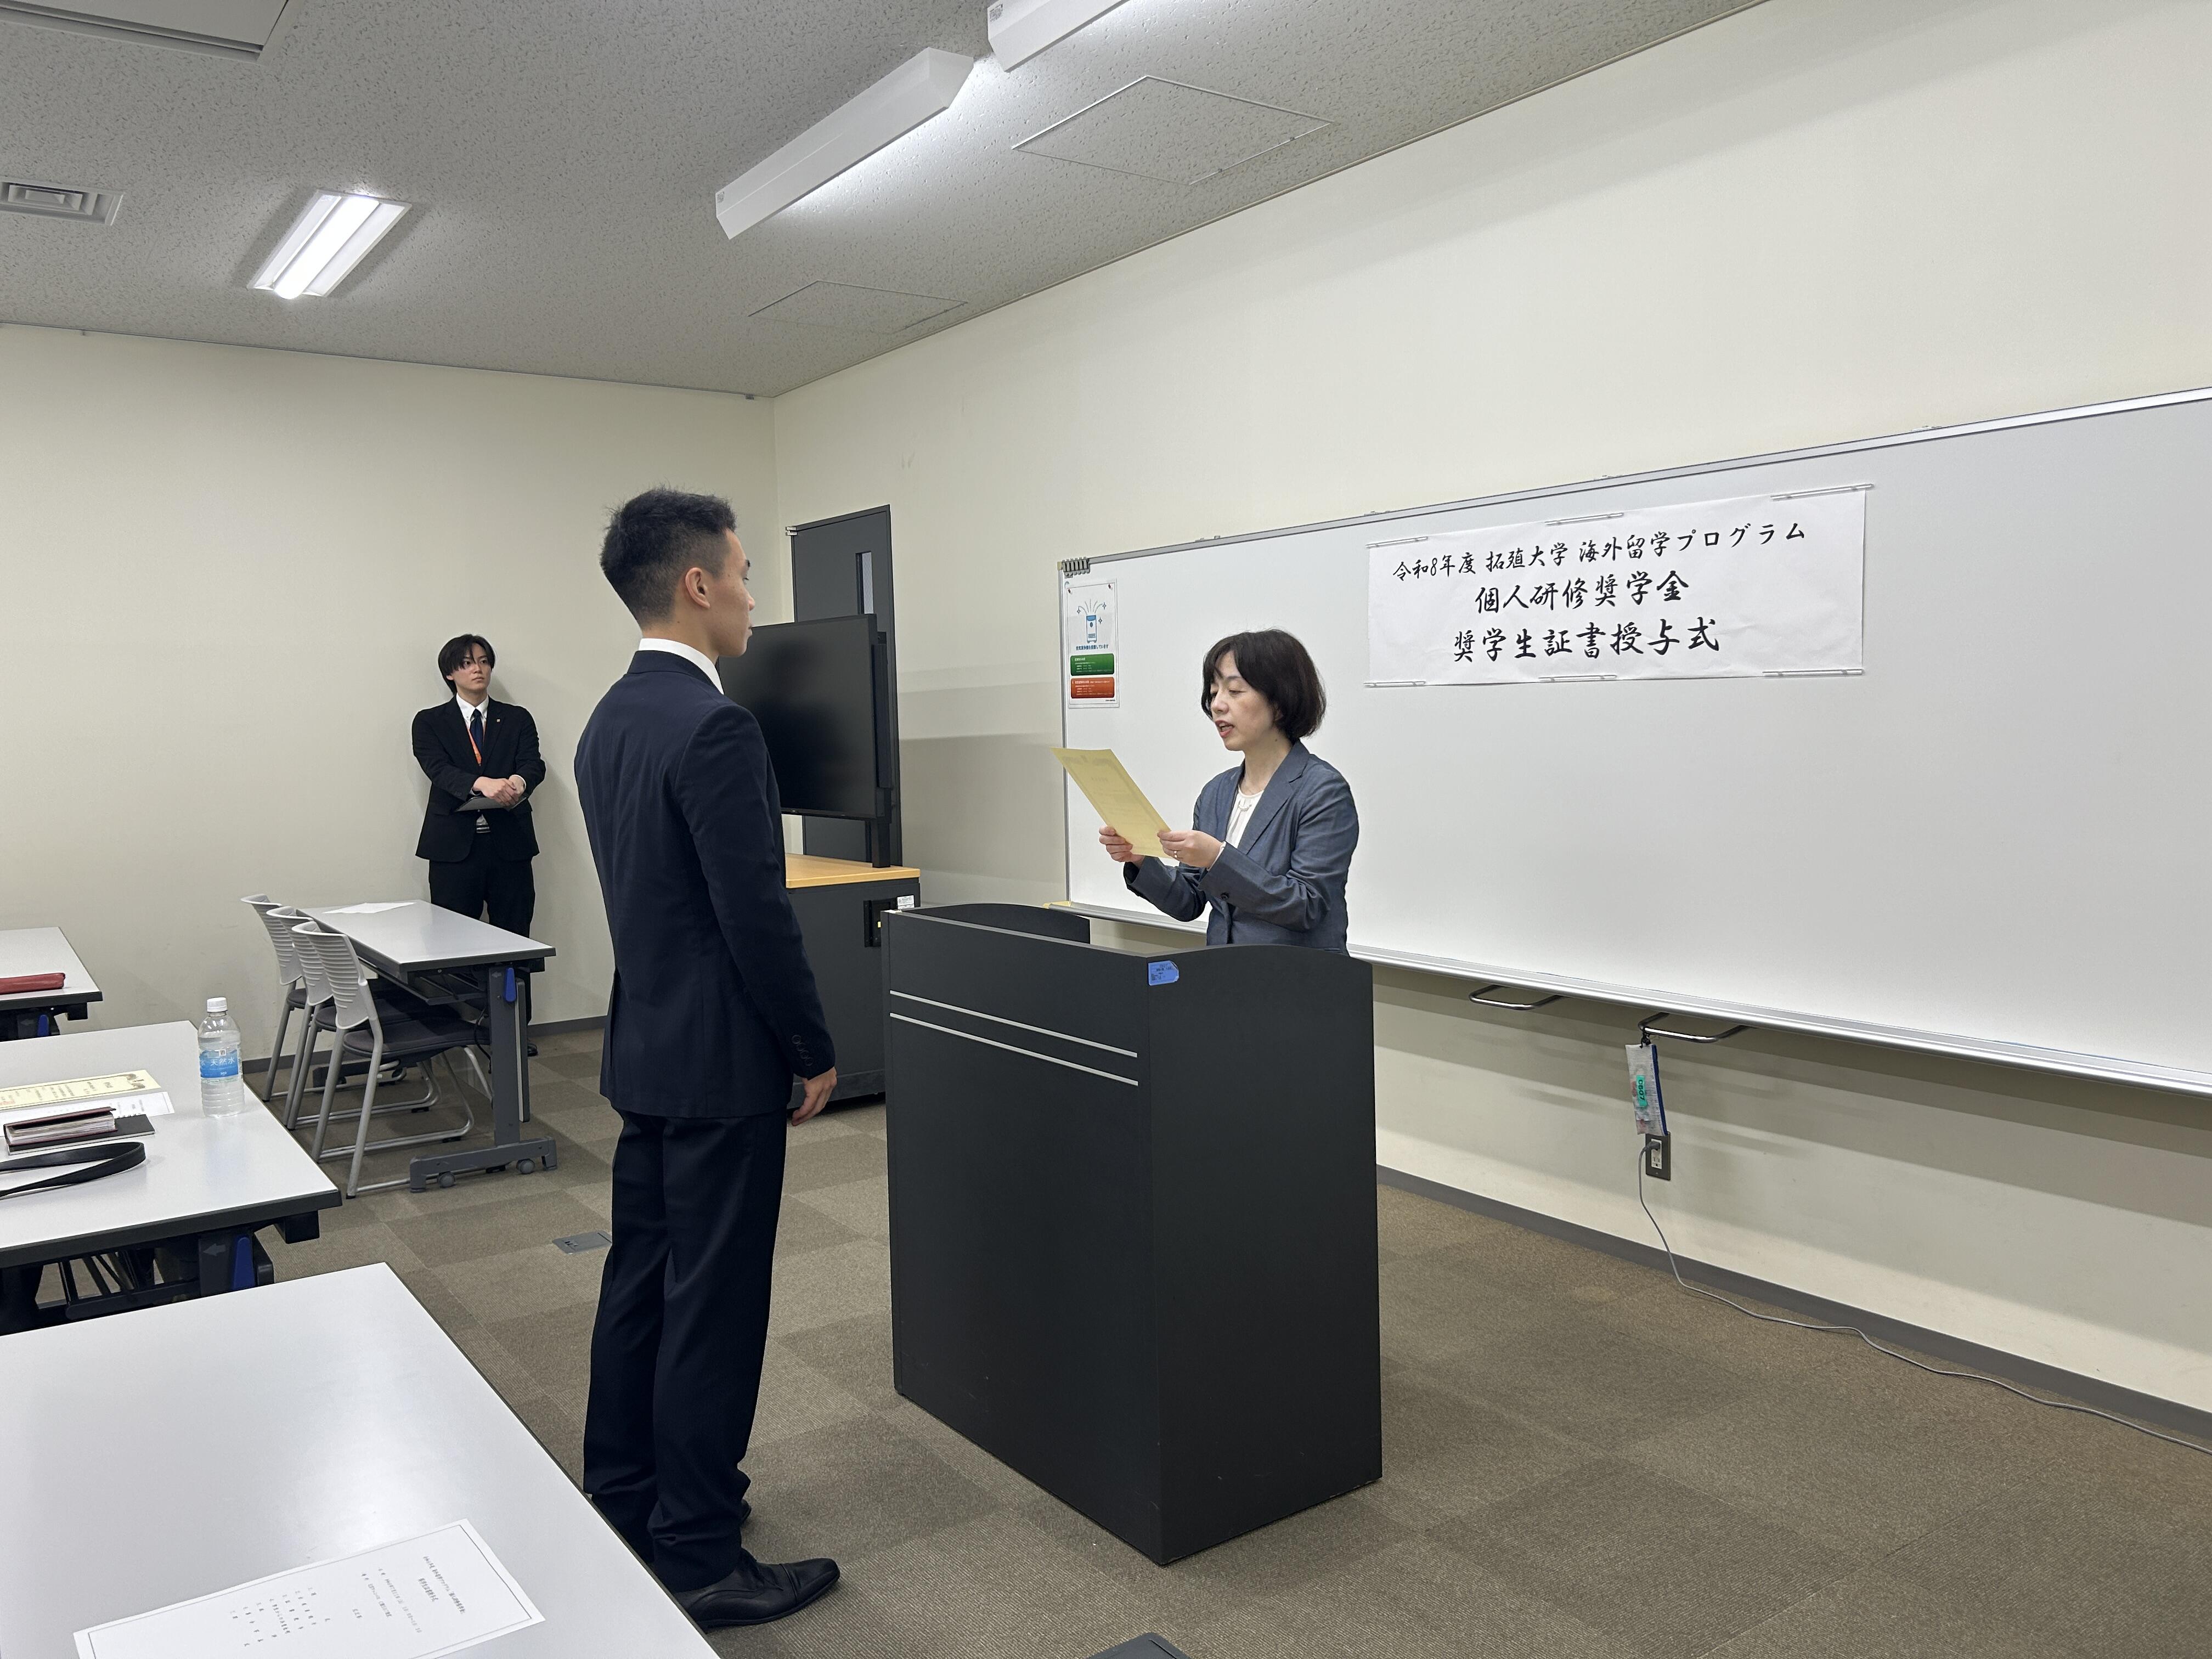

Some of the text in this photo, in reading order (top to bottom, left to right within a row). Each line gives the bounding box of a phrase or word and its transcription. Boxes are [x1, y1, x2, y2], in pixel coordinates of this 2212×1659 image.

[1392, 523, 1804, 582] 令和8年度 拓殖大学 海外留学プログラム
[1475, 570, 1689, 614] 個人研修奨学金
[1454, 617, 1719, 662] 奨学生証書授与式
[210, 1057, 235, 1066] 天然水
